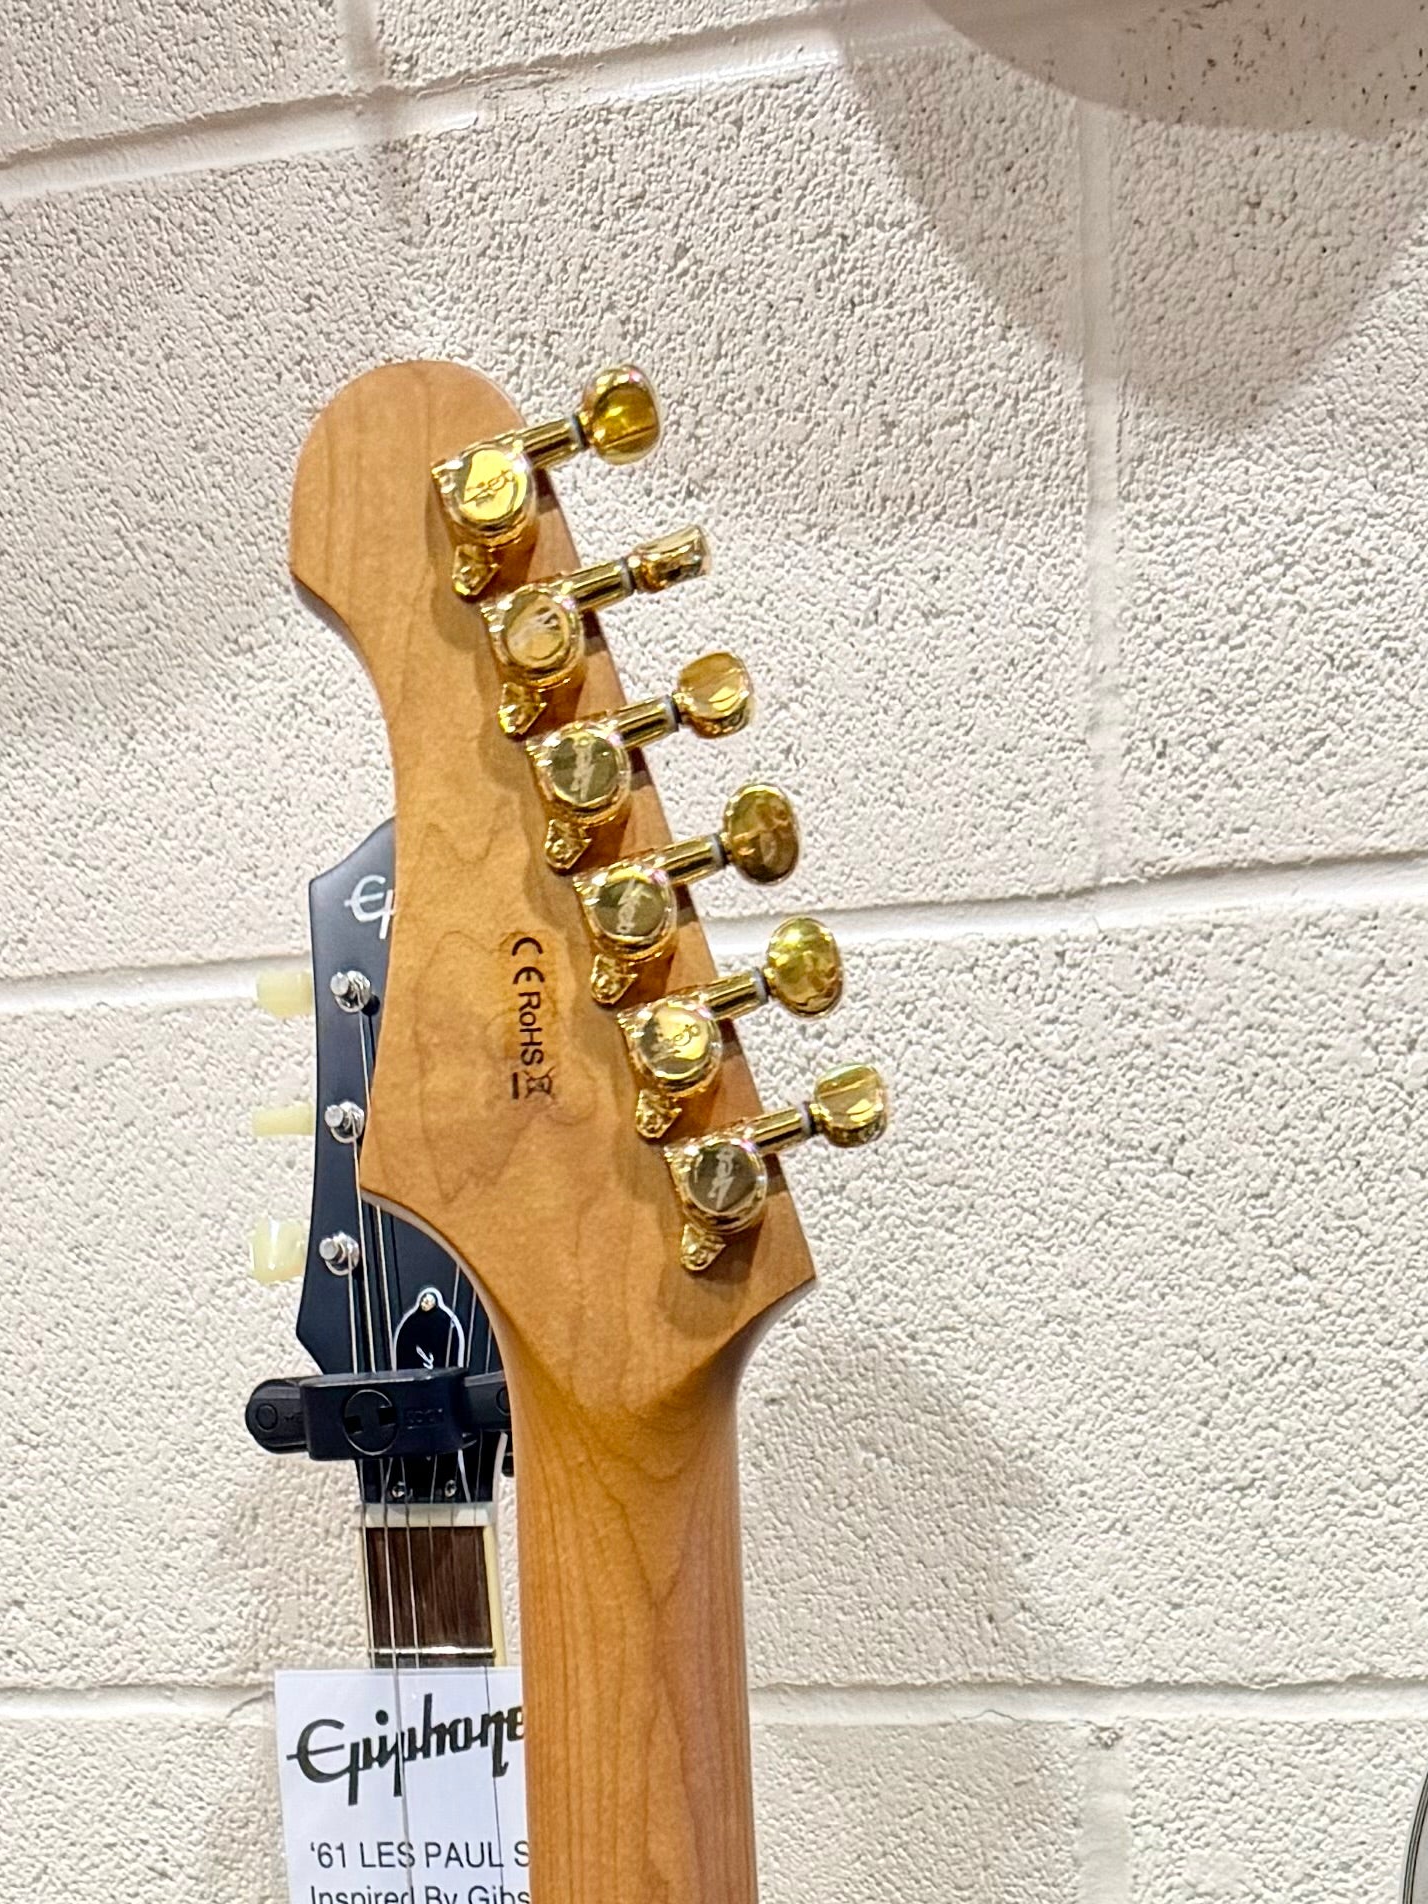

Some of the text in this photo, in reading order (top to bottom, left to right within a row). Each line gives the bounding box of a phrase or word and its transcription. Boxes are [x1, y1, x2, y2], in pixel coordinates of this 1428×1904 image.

[518, 992, 544, 1066] RoHS
[286, 1693, 525, 1805] Epiphone
[359, 1842, 414, 1868] LES
[426, 1842, 503, 1868] PAUL
